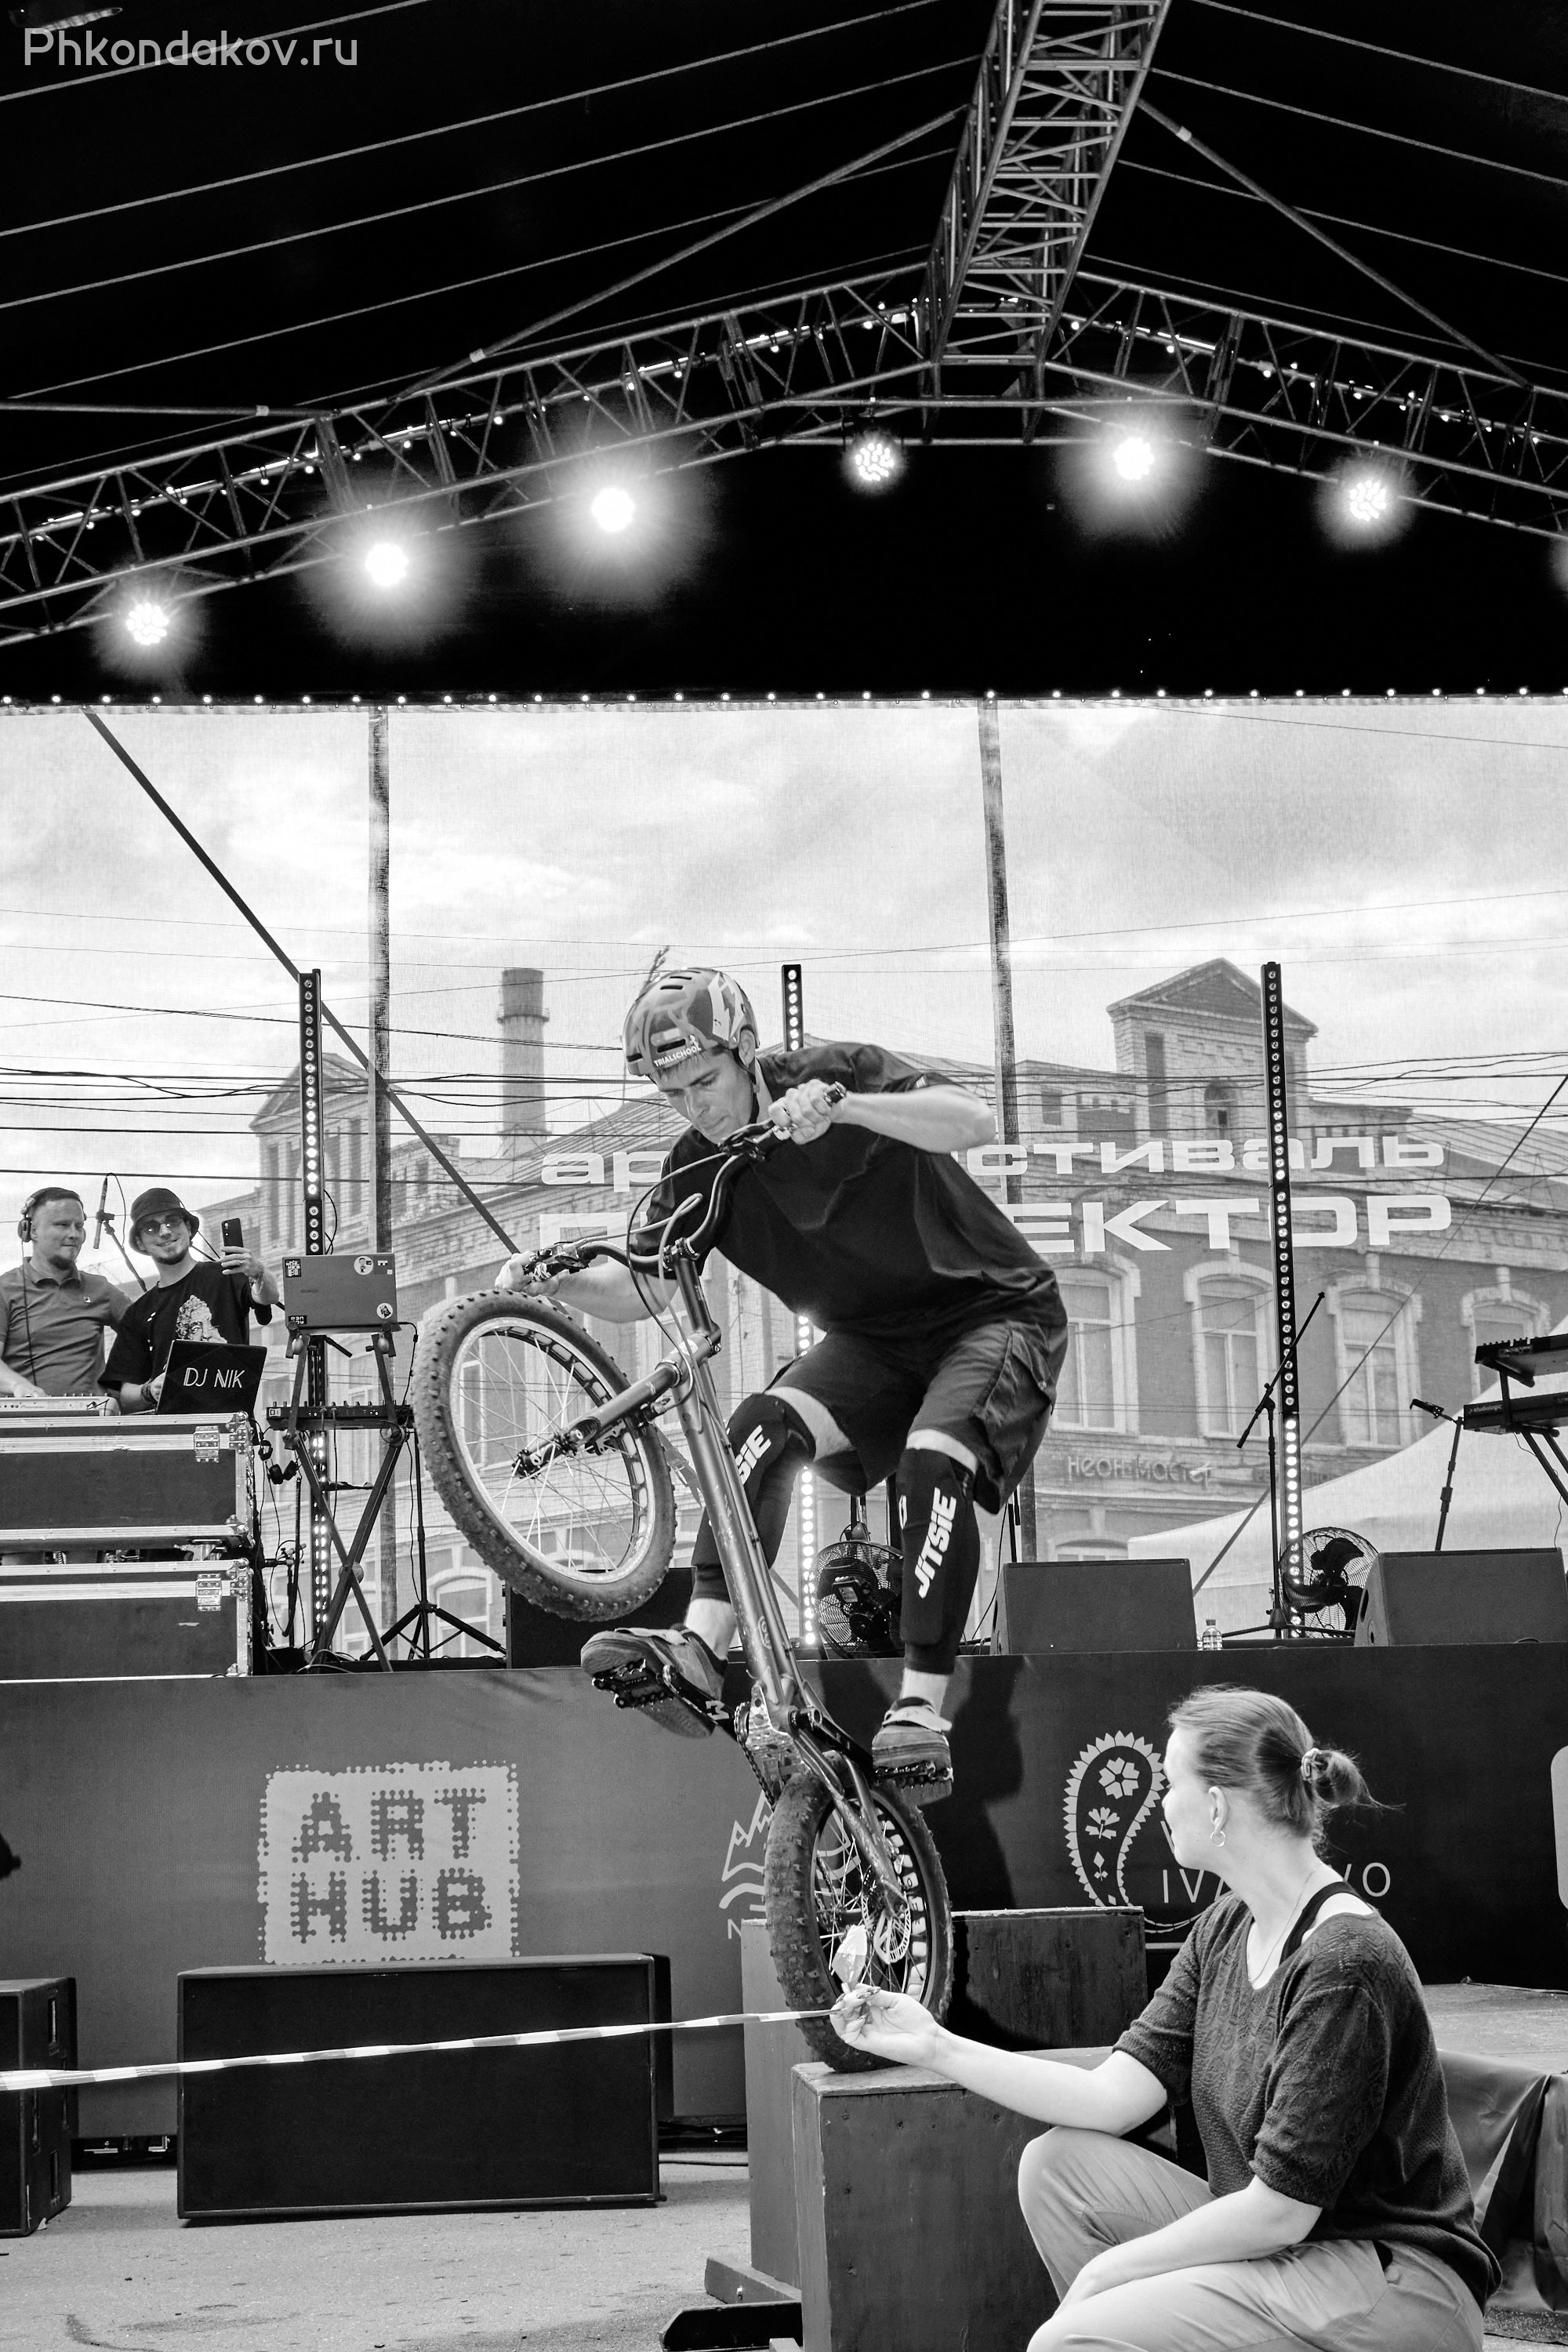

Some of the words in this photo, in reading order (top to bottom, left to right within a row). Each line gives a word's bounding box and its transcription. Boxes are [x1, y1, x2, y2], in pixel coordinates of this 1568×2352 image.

[541, 1150, 673, 1192] ар
[950, 1136, 1445, 1176] стиваль
[183, 1367, 208, 1387] DJ
[214, 1369, 245, 1388] NIK
[292, 1791, 487, 1863] ART
[291, 1867, 492, 1944] HUB
